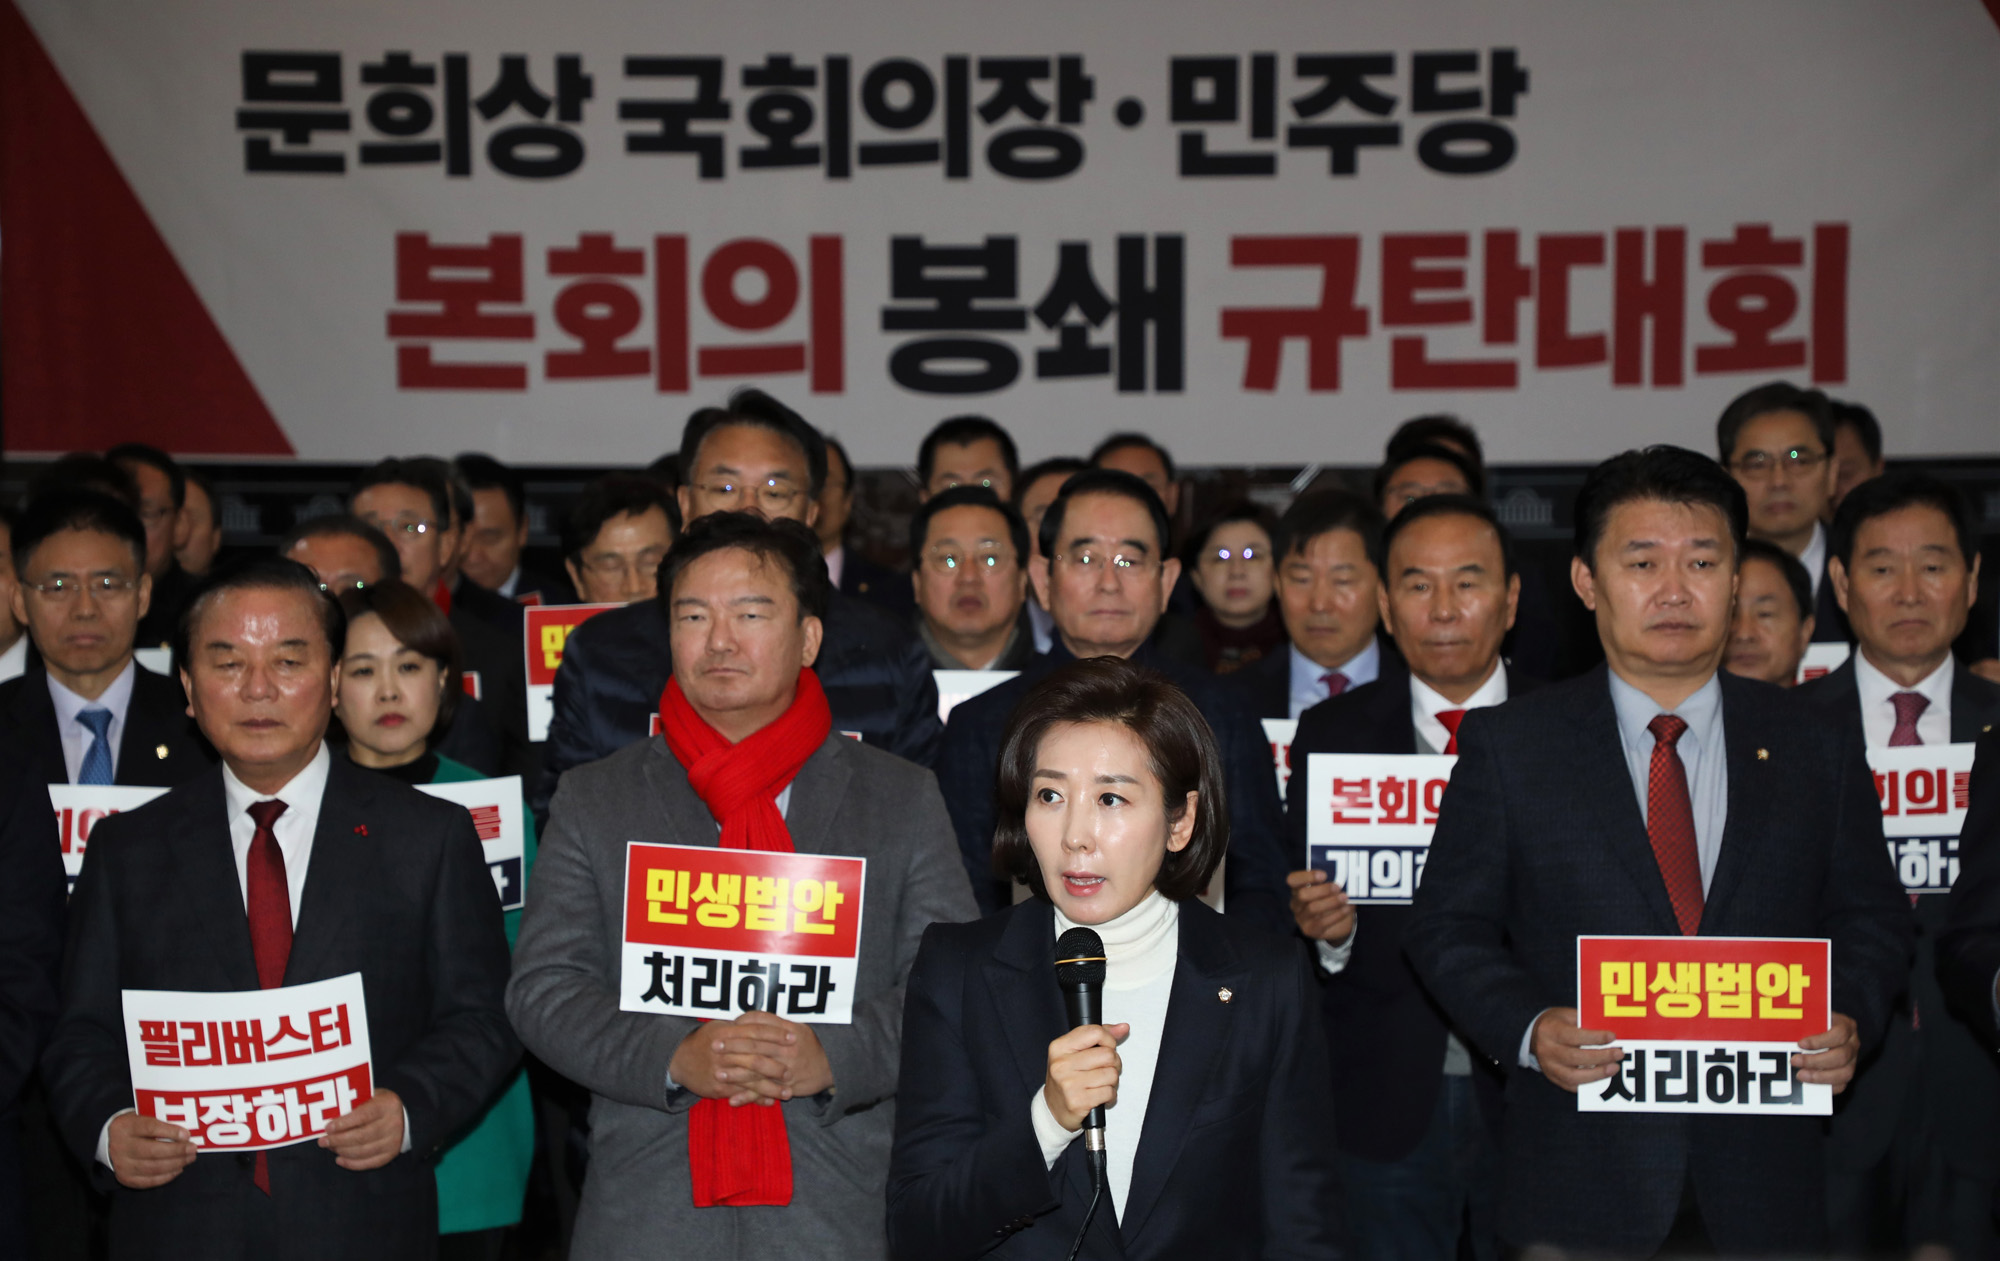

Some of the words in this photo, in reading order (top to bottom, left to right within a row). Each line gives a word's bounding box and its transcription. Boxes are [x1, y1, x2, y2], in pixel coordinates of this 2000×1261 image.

[236, 49, 594, 180] 문희상
[386, 231, 845, 395] 본회의
[880, 232, 1186, 397] 봉쇄
[1219, 221, 1851, 393] 규탄대회
[646, 868, 844, 935] 민생법안
[640, 951, 836, 1015] 처리하라
[1600, 961, 1810, 1019] 민생법안
[138, 1003, 351, 1067] 필리버스터
